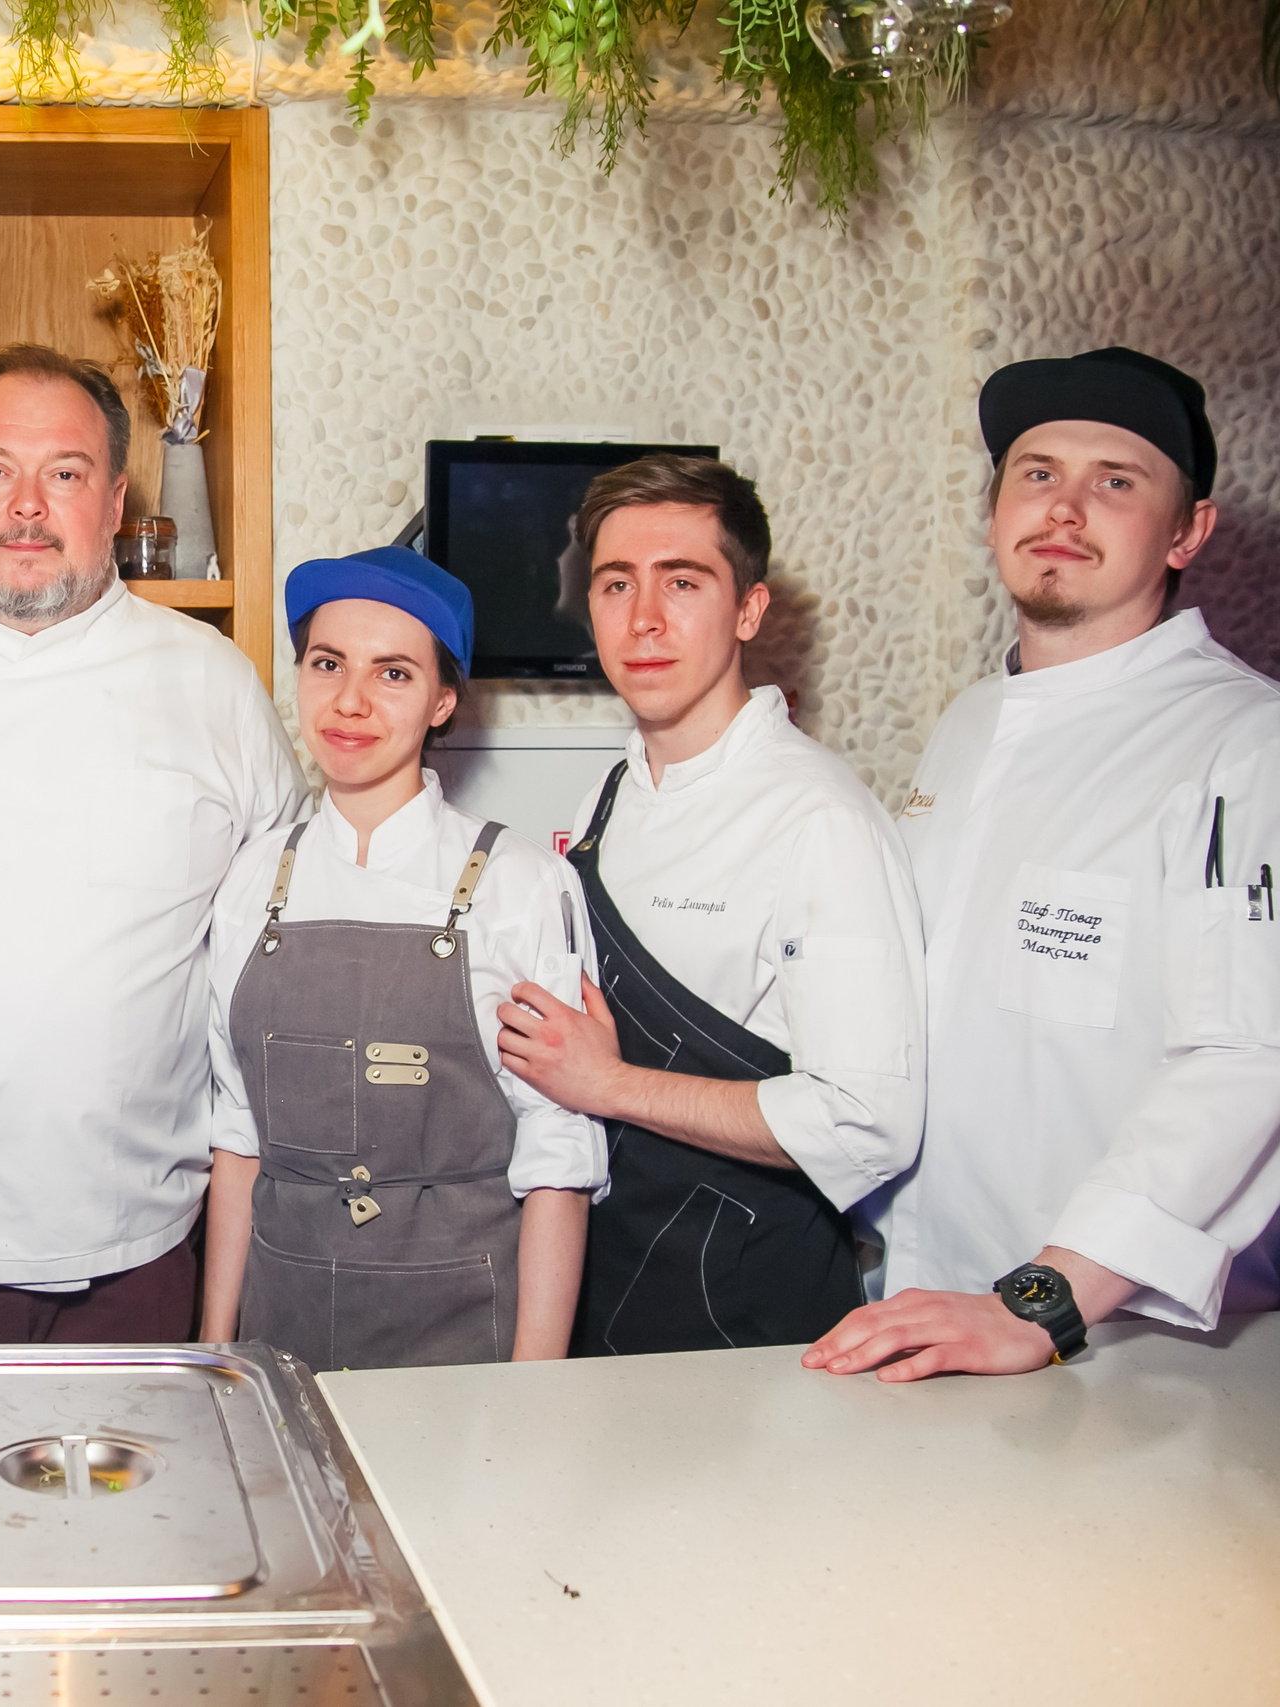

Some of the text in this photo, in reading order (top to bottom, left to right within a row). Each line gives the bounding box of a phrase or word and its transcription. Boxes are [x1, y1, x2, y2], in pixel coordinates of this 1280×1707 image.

[651, 896, 727, 915] Рейн Дмитрий
[1018, 919, 1101, 944] Дмитриев
[1021, 939, 1089, 961] Максим
